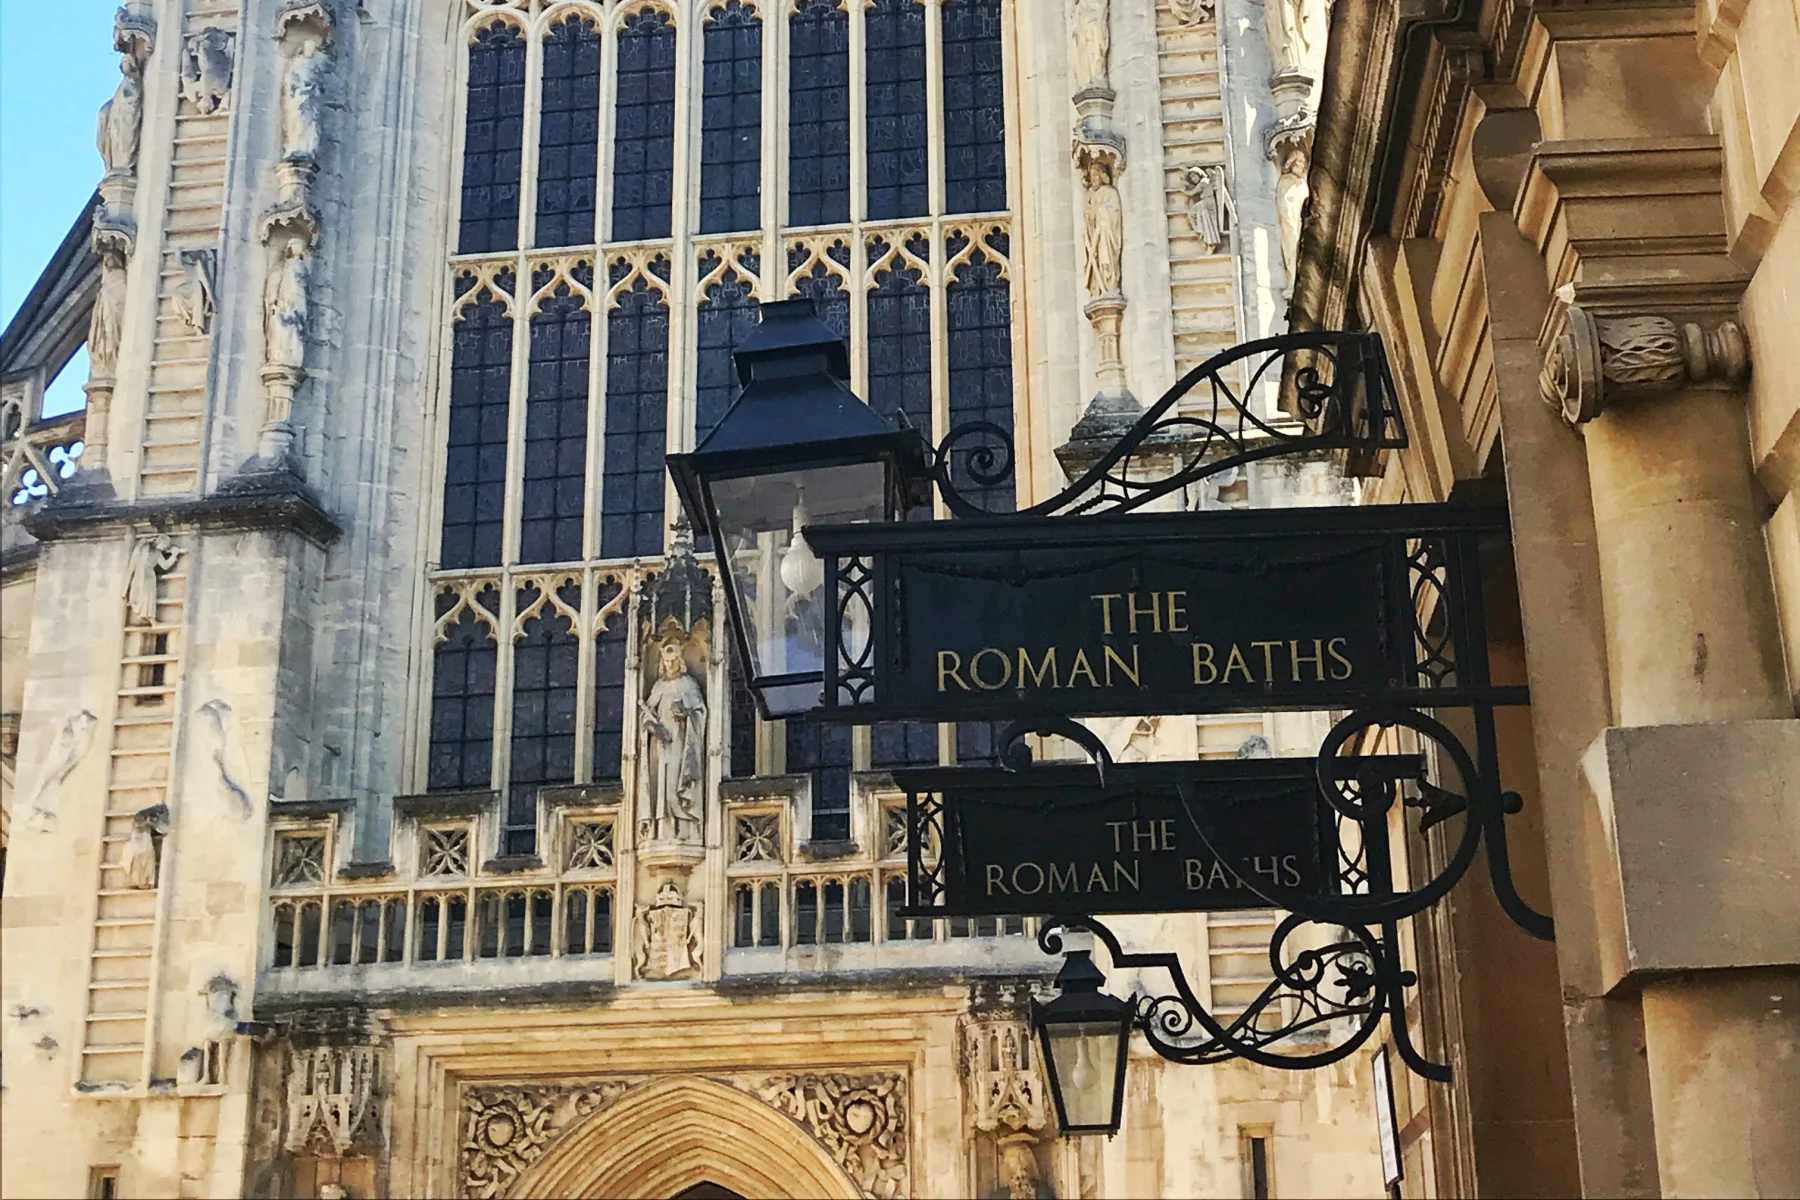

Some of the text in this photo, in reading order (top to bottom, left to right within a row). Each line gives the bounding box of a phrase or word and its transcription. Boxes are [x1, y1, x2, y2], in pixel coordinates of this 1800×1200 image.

[1091, 591, 1189, 635] THE
[937, 637, 1353, 692] ROMAN BATHS
[1105, 819, 1177, 853] THE
[986, 855, 1301, 896] ROMAN BAHS
